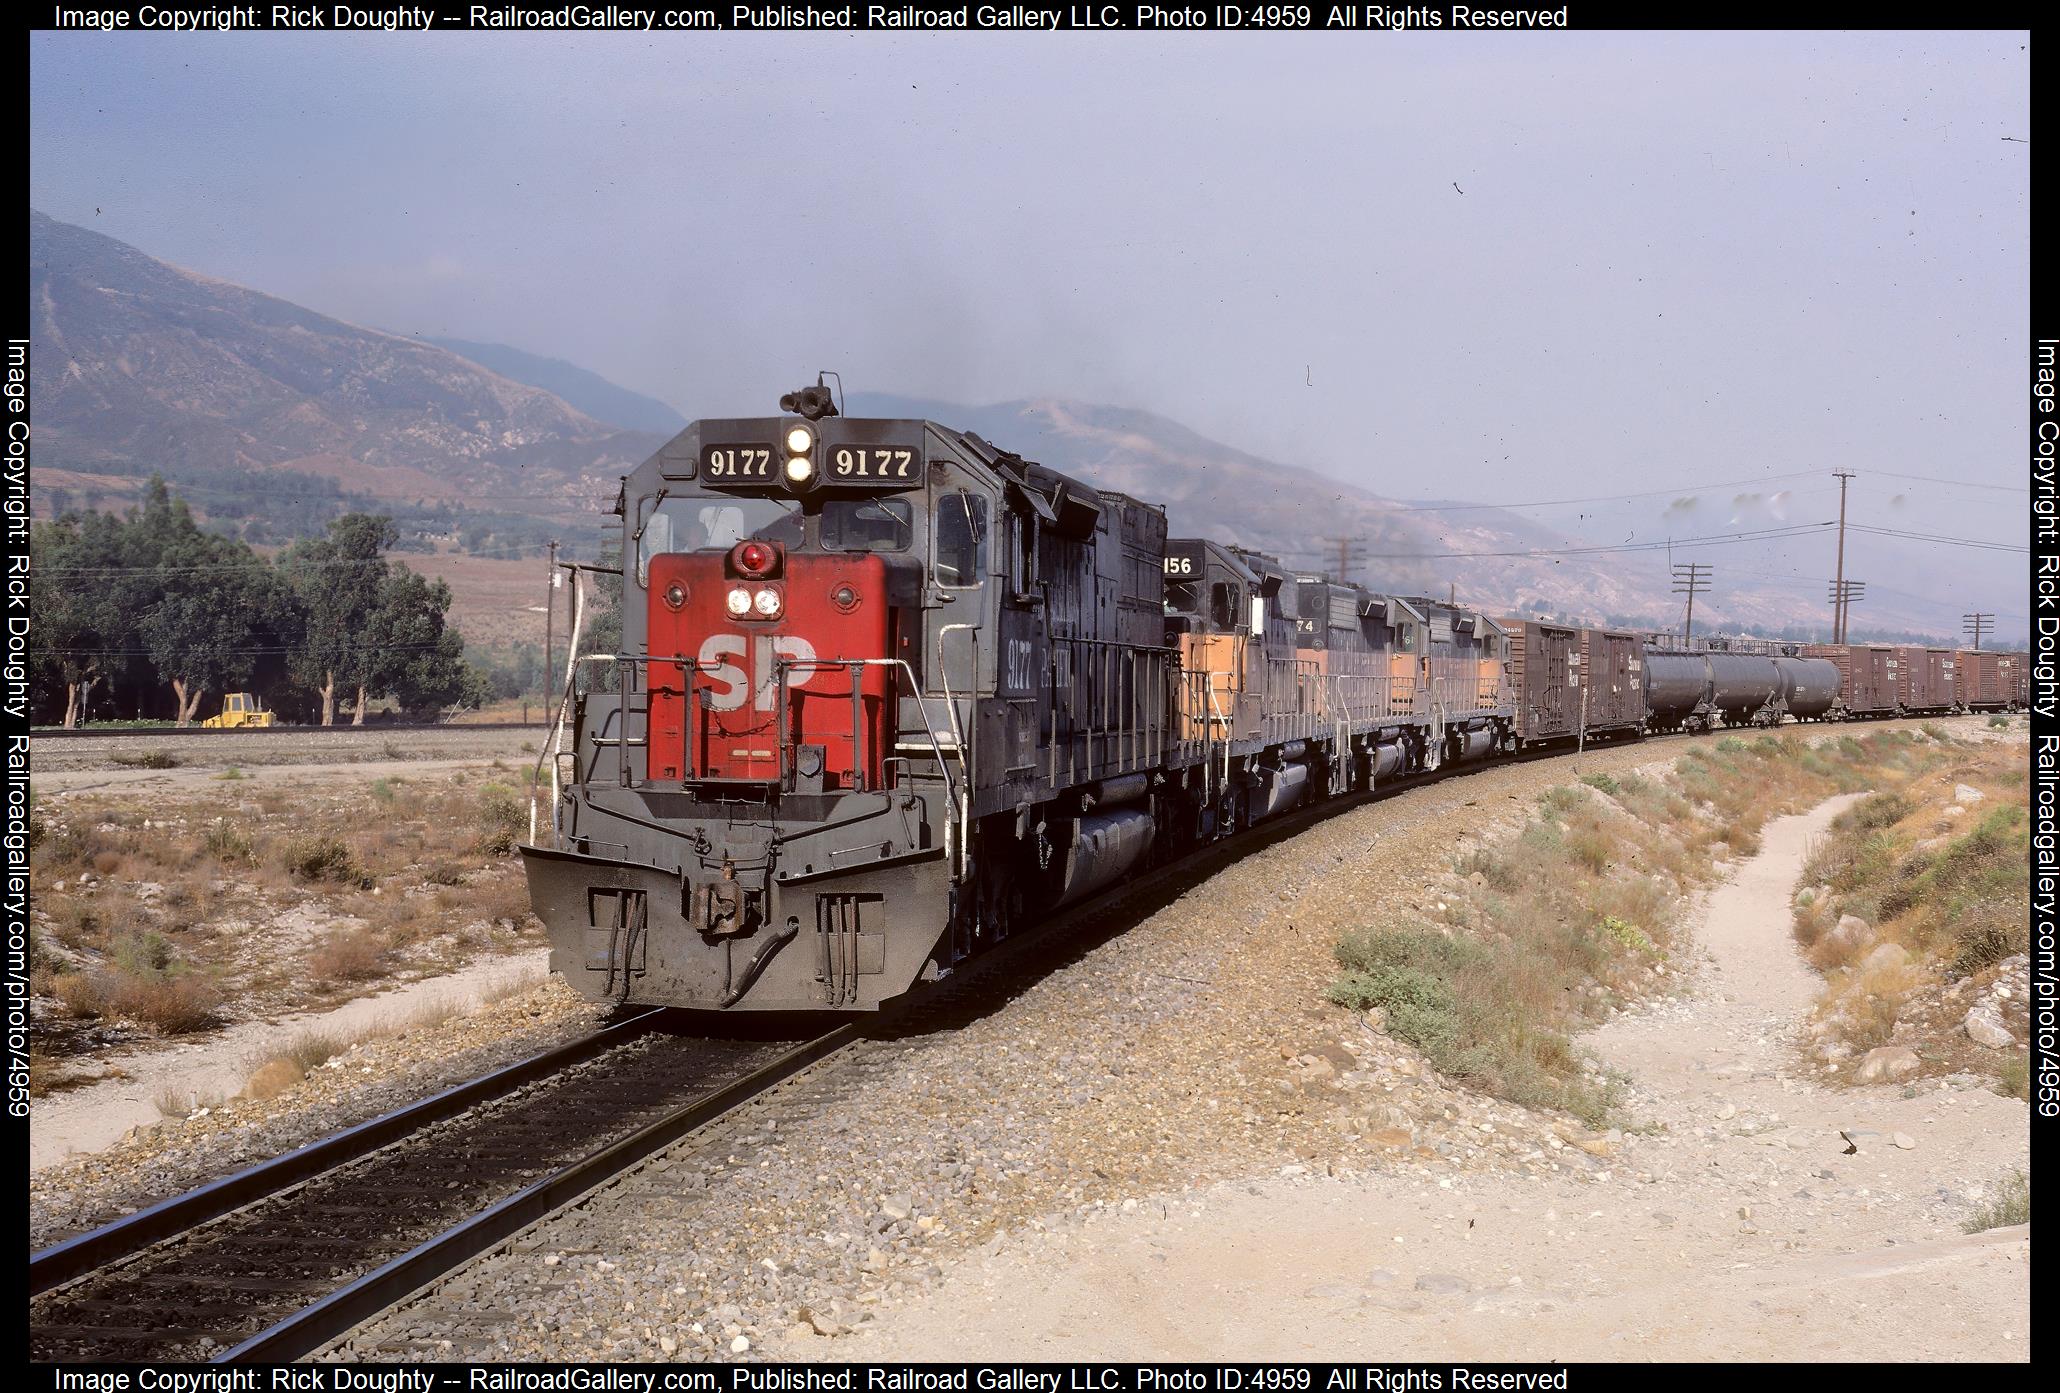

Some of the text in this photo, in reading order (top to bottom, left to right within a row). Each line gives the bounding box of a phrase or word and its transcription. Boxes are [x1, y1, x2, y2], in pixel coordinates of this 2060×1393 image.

[710, 449, 770, 476] 9177
[836, 449, 912, 477] 9177
[1163, 557, 1191, 574] 156
[698, 633, 817, 713] SP
[1008, 639, 1032, 689] 9177
